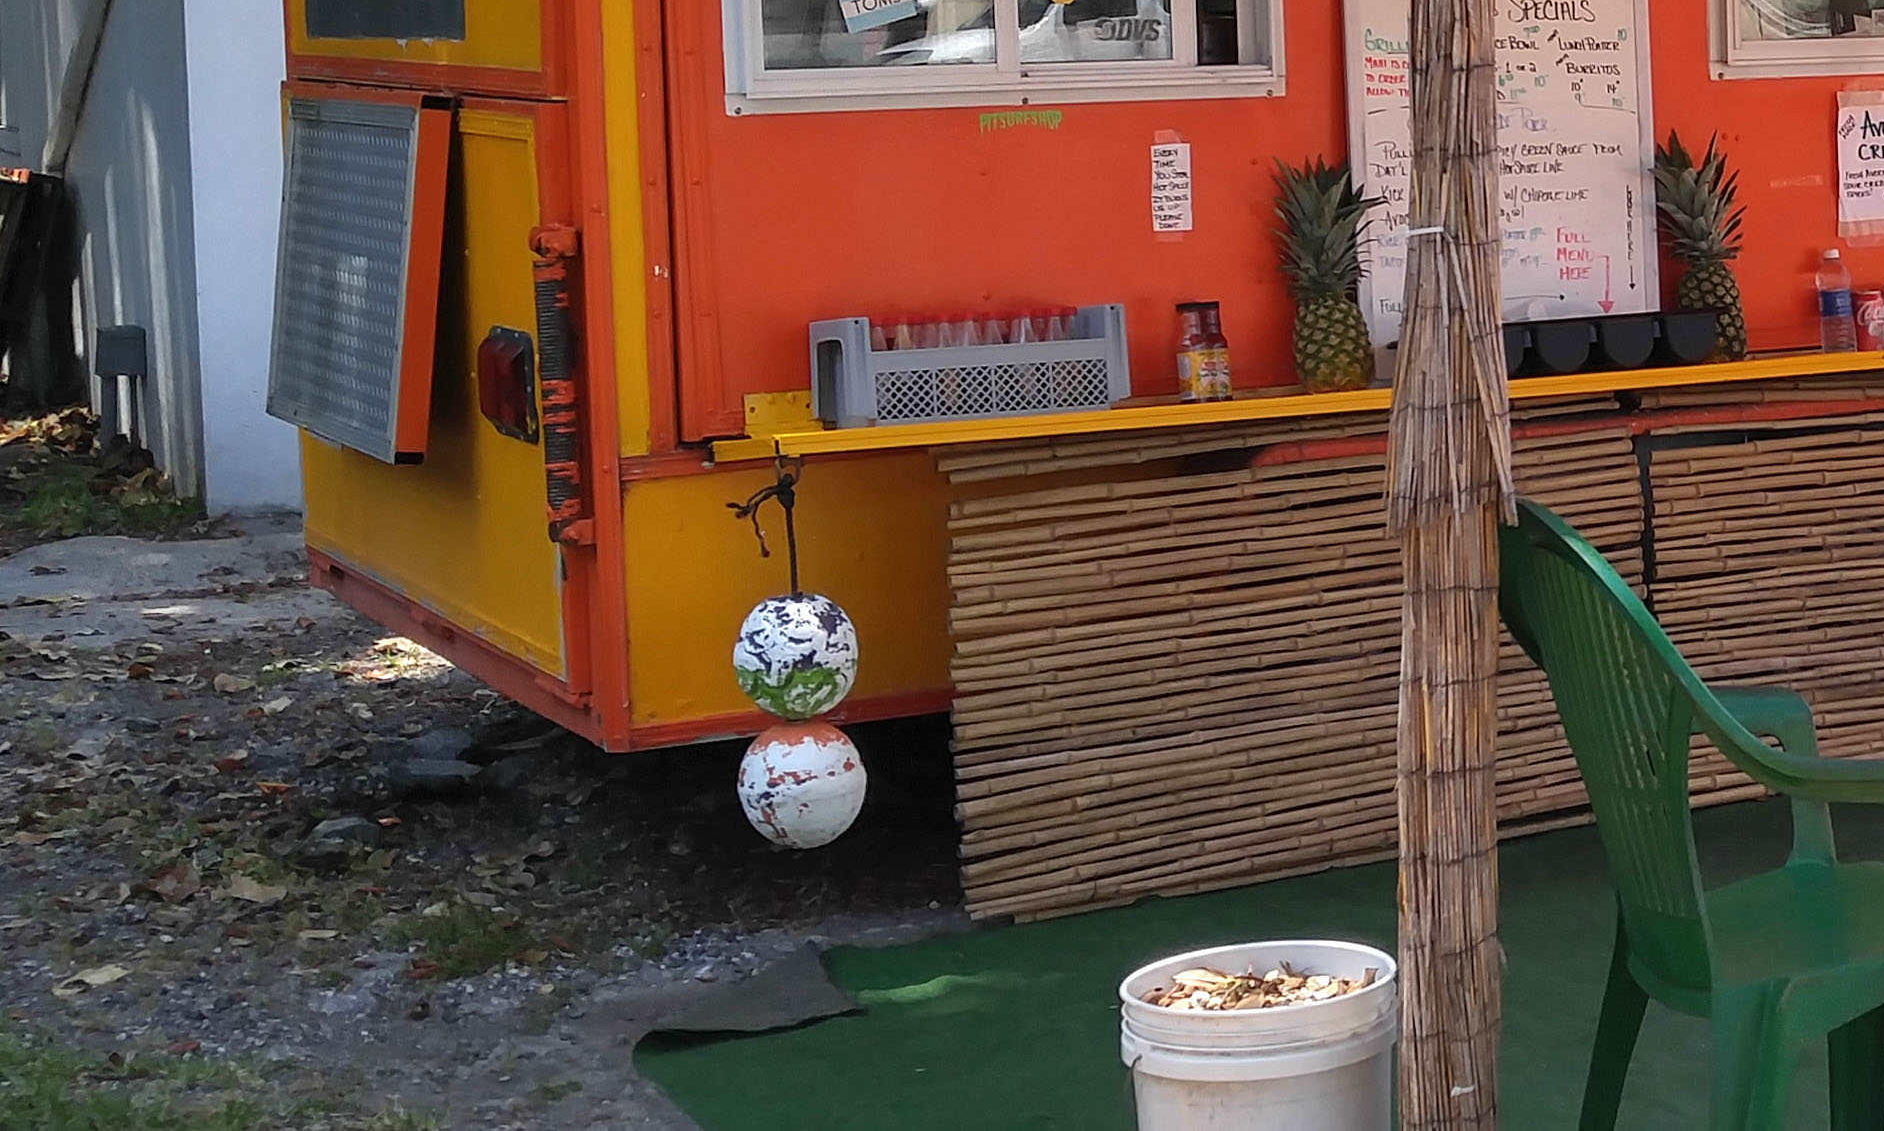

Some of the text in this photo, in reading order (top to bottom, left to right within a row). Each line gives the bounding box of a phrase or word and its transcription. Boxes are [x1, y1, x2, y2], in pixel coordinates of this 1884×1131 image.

[1116, 18, 1162, 41] DVS
[1507, 35, 1539, 50] BOWL
[1565, 62, 1620, 75] BURRITOS
[1556, 226, 1592, 243] FULL
[1556, 247, 1595, 262] MENU
